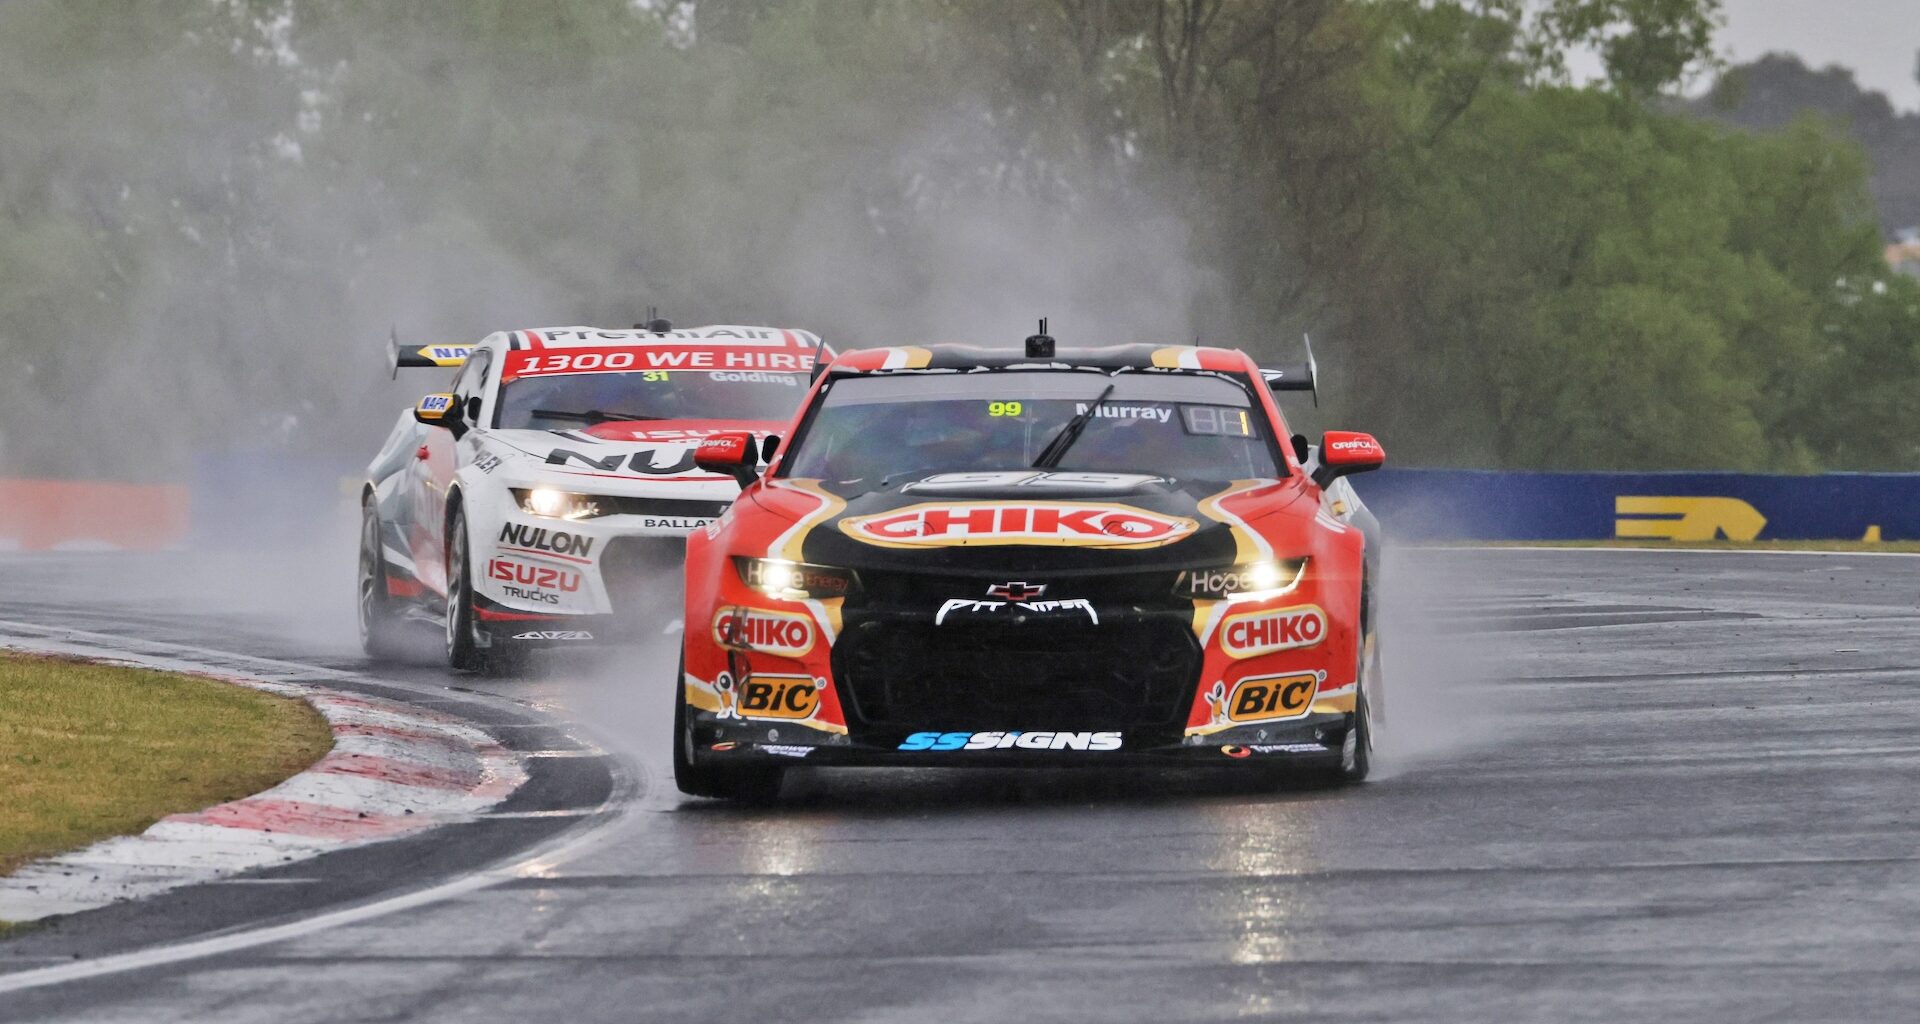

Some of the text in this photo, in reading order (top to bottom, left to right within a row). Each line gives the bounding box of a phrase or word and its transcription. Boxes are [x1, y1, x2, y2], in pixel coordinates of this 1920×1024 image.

[433, 348, 472, 358] NA
[516, 351, 817, 374] 1300 WE HIRE
[642, 371, 798, 386] 31 Golding
[421, 396, 449, 410] NAPA
[988, 402, 1022, 417] 99
[645, 519, 715, 528] BALLA
[863, 508, 1180, 539] CHIKO
[500, 521, 594, 558] NULON
[488, 559, 581, 593] ISUZU
[502, 586, 560, 605] TRUCKS
[718, 614, 809, 648] CHIKO
[1226, 613, 1321, 649] CHIKO
